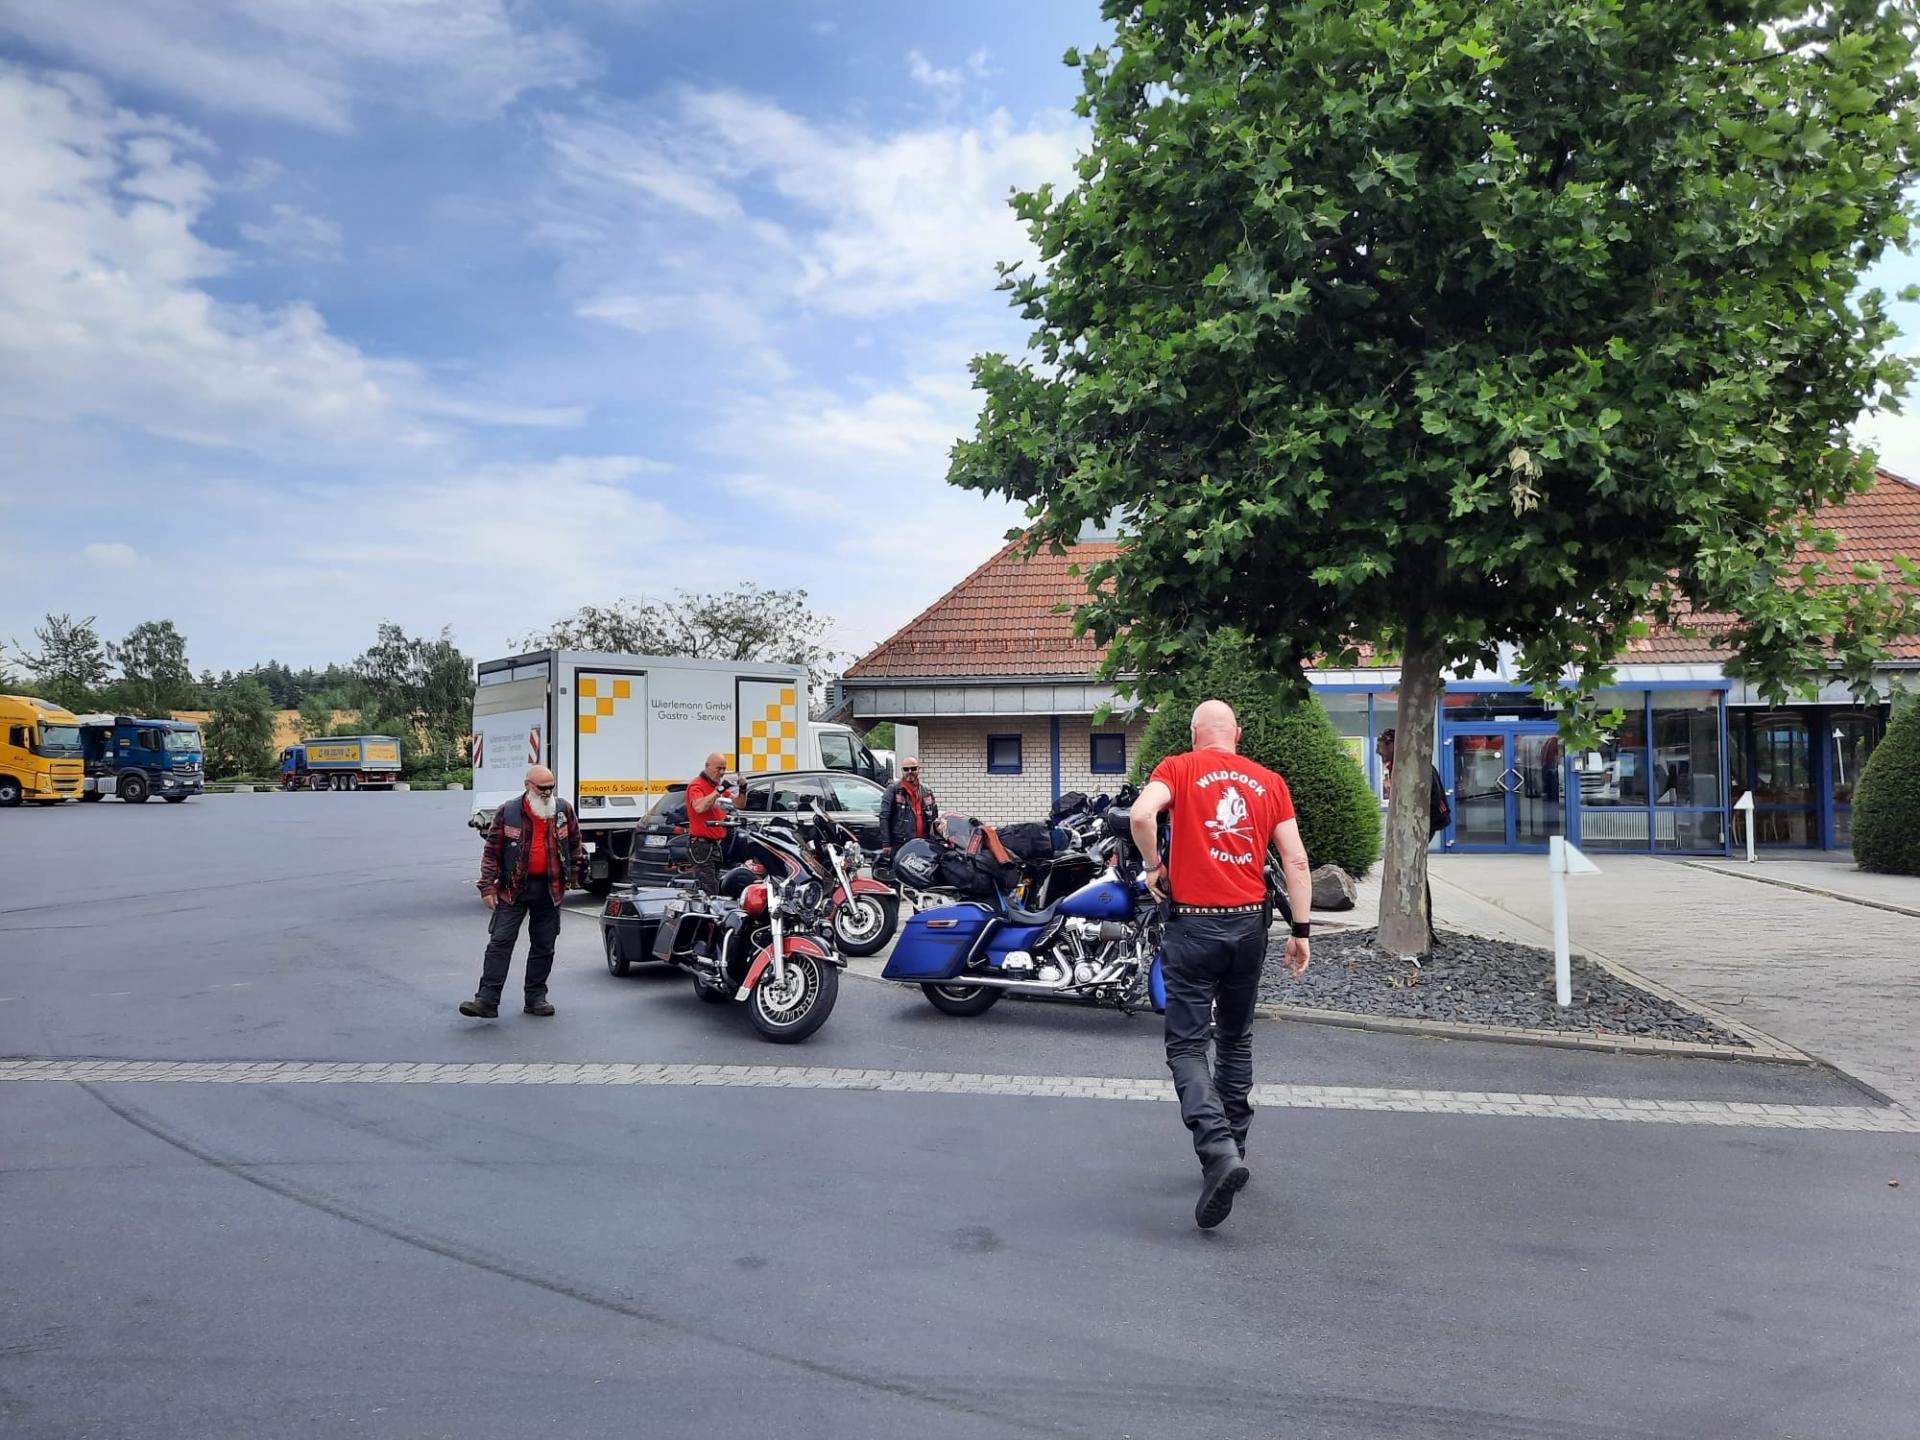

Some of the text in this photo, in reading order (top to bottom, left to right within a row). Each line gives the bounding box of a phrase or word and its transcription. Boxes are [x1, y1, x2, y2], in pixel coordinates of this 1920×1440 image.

[705, 701, 732, 712] GmbH
[657, 710, 689, 721] Gastro
[696, 711, 726, 722] Service
[612, 784, 618, 792] &
[1196, 770, 1266, 797] WILDCOCK
